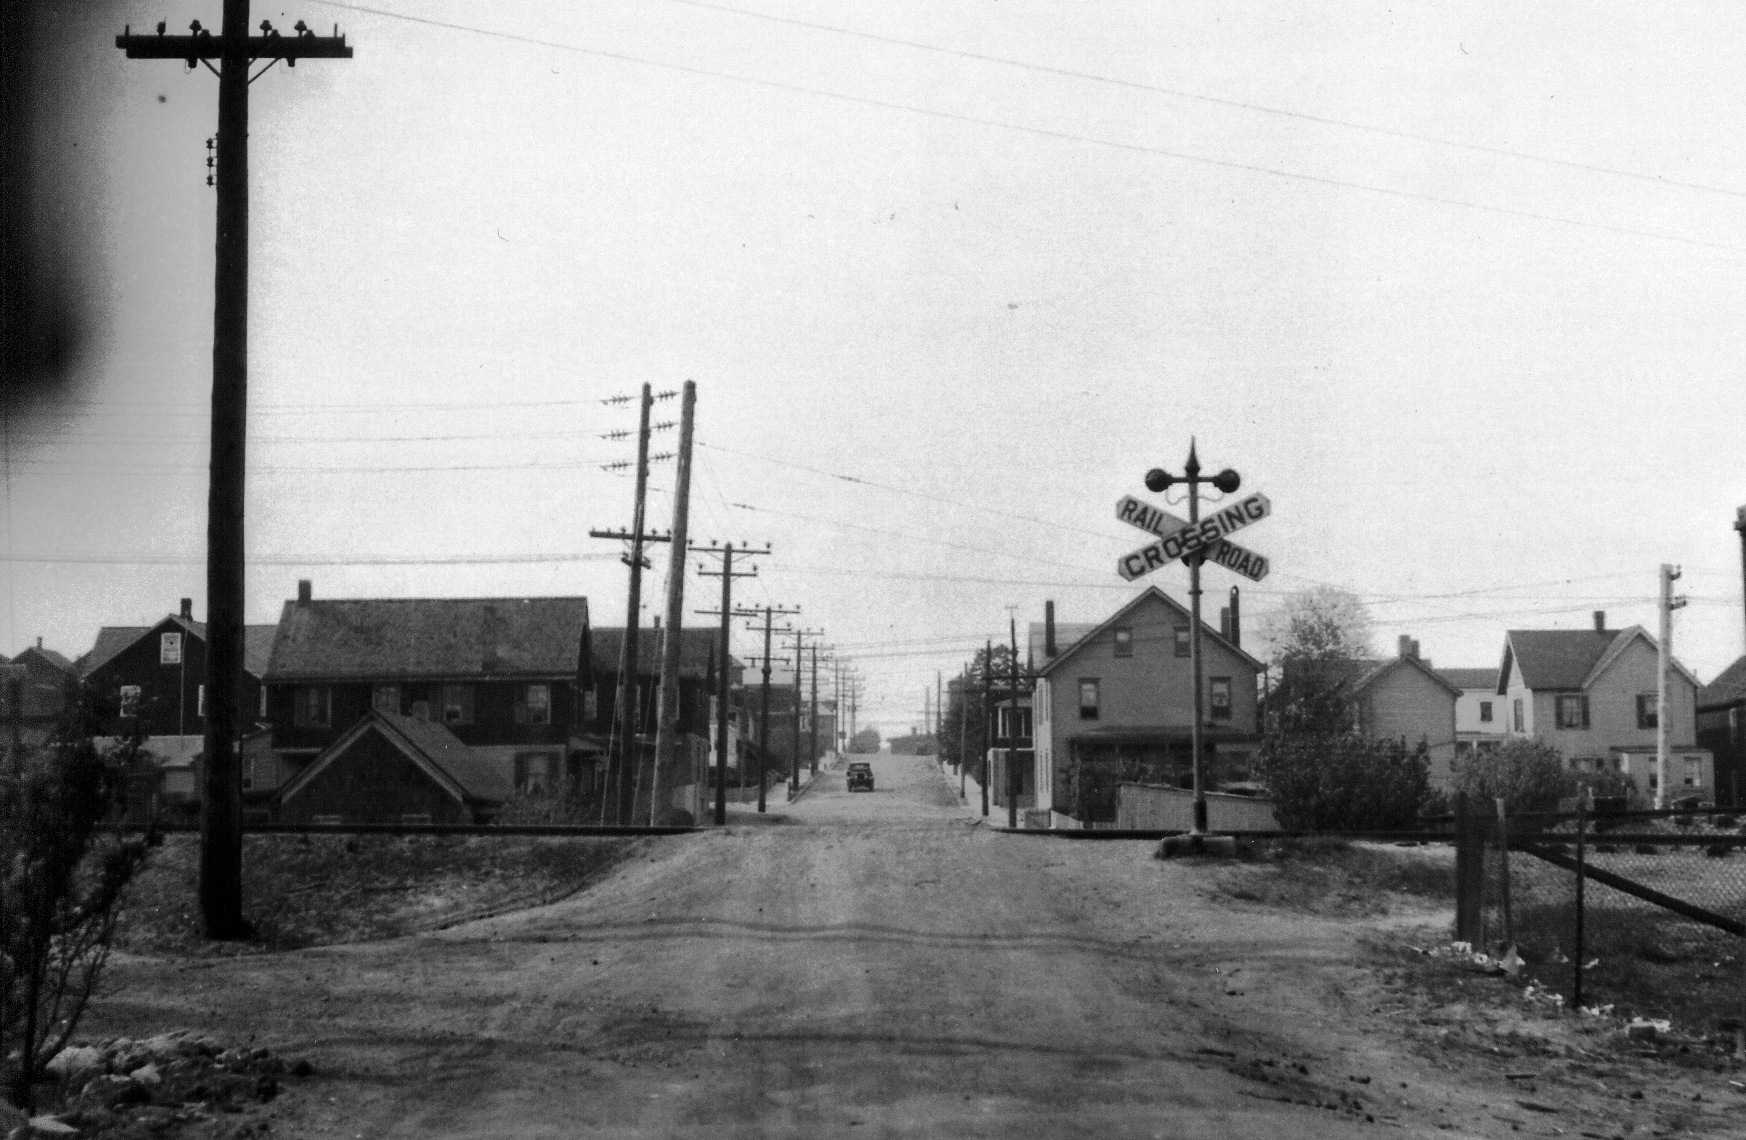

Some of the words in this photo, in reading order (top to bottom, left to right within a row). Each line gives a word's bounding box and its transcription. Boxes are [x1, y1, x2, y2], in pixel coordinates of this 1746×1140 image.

[1121, 499, 1164, 536] RAIL
[1216, 541, 1265, 578] ROAD
[1124, 497, 1264, 577] CROSSING
